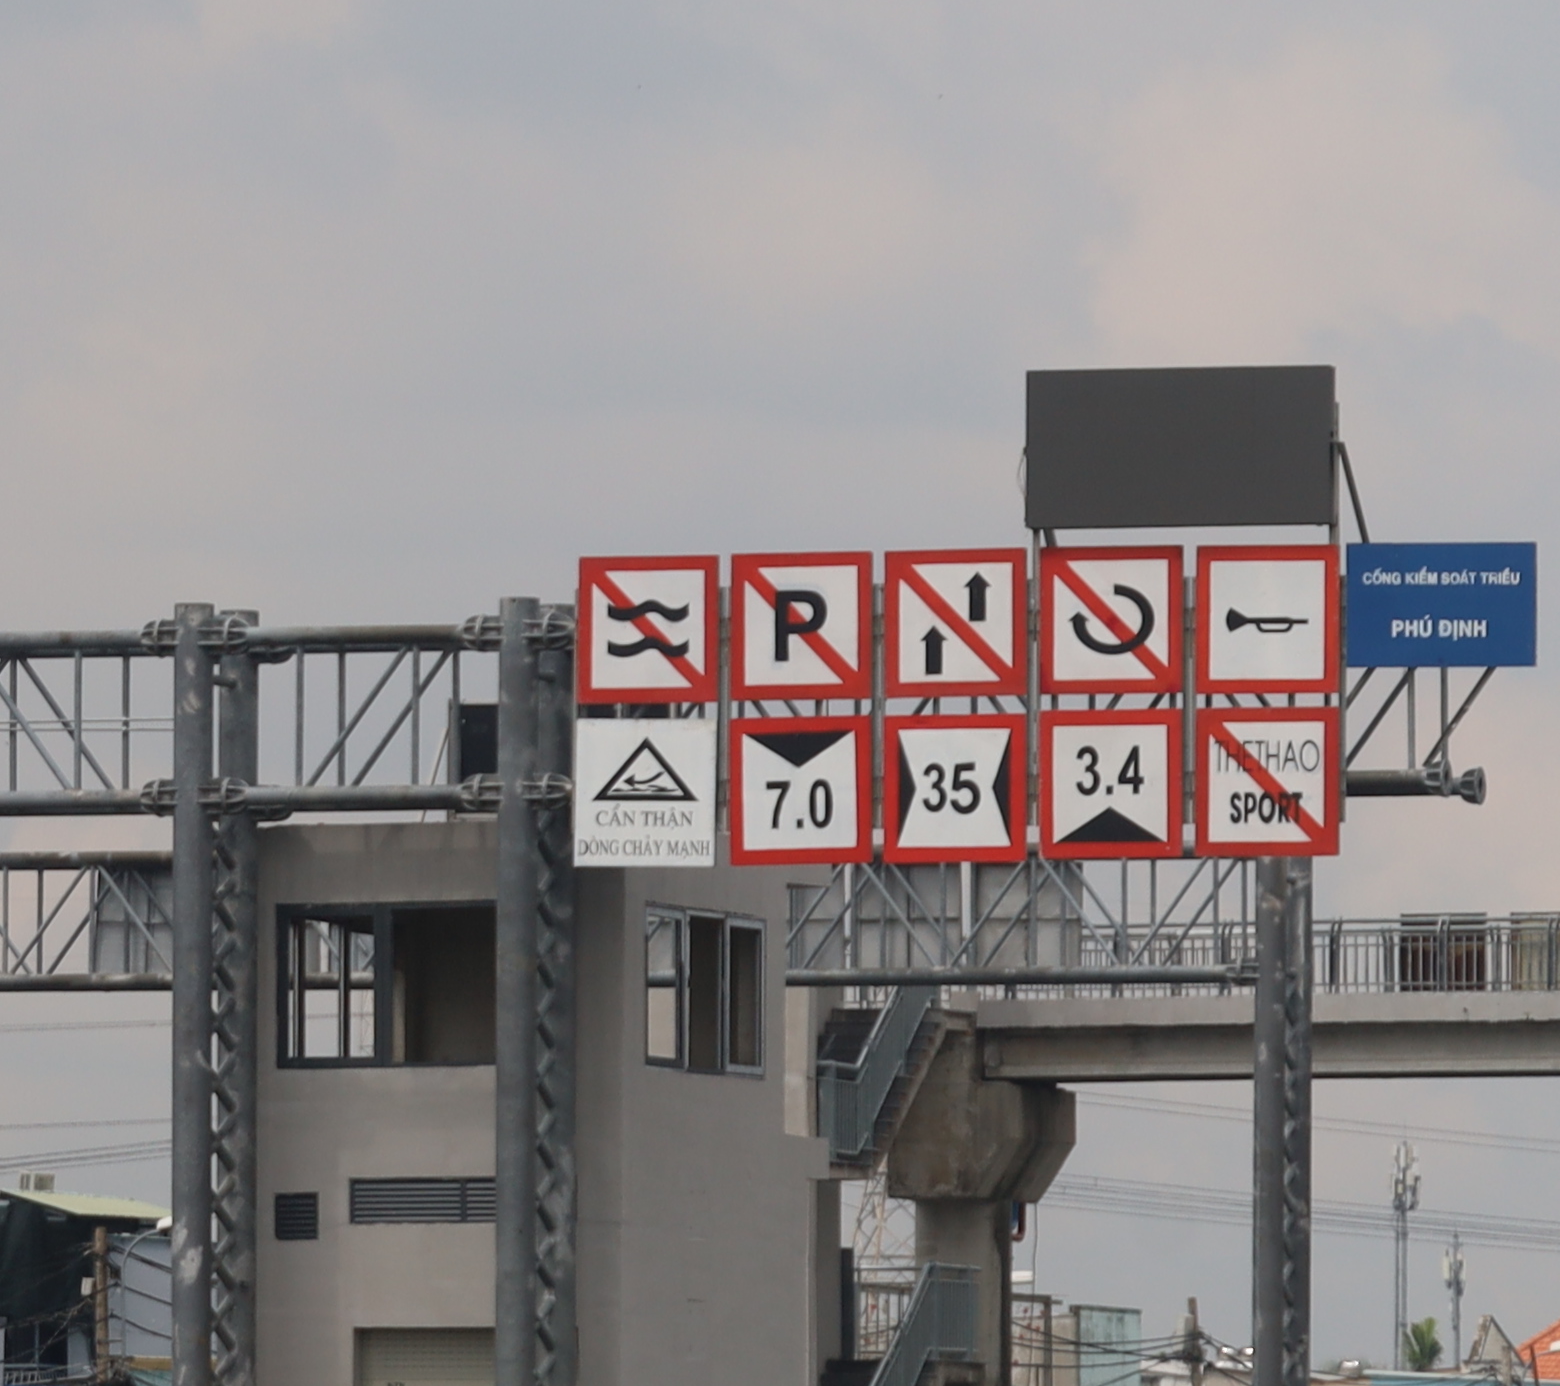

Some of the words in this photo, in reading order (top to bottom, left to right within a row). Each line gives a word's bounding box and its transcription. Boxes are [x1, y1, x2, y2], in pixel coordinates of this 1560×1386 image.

[774, 589, 828, 662] P
[1391, 614, 1433, 638] PHÚ
[1438, 619, 1487, 641] ĐỊNH
[922, 761, 981, 815] 35
[1075, 745, 1145, 796] 3.4
[641, 806, 693, 830] THẬN
[766, 778, 834, 829] 7.0
[1230, 791, 1303, 824] SPORT
